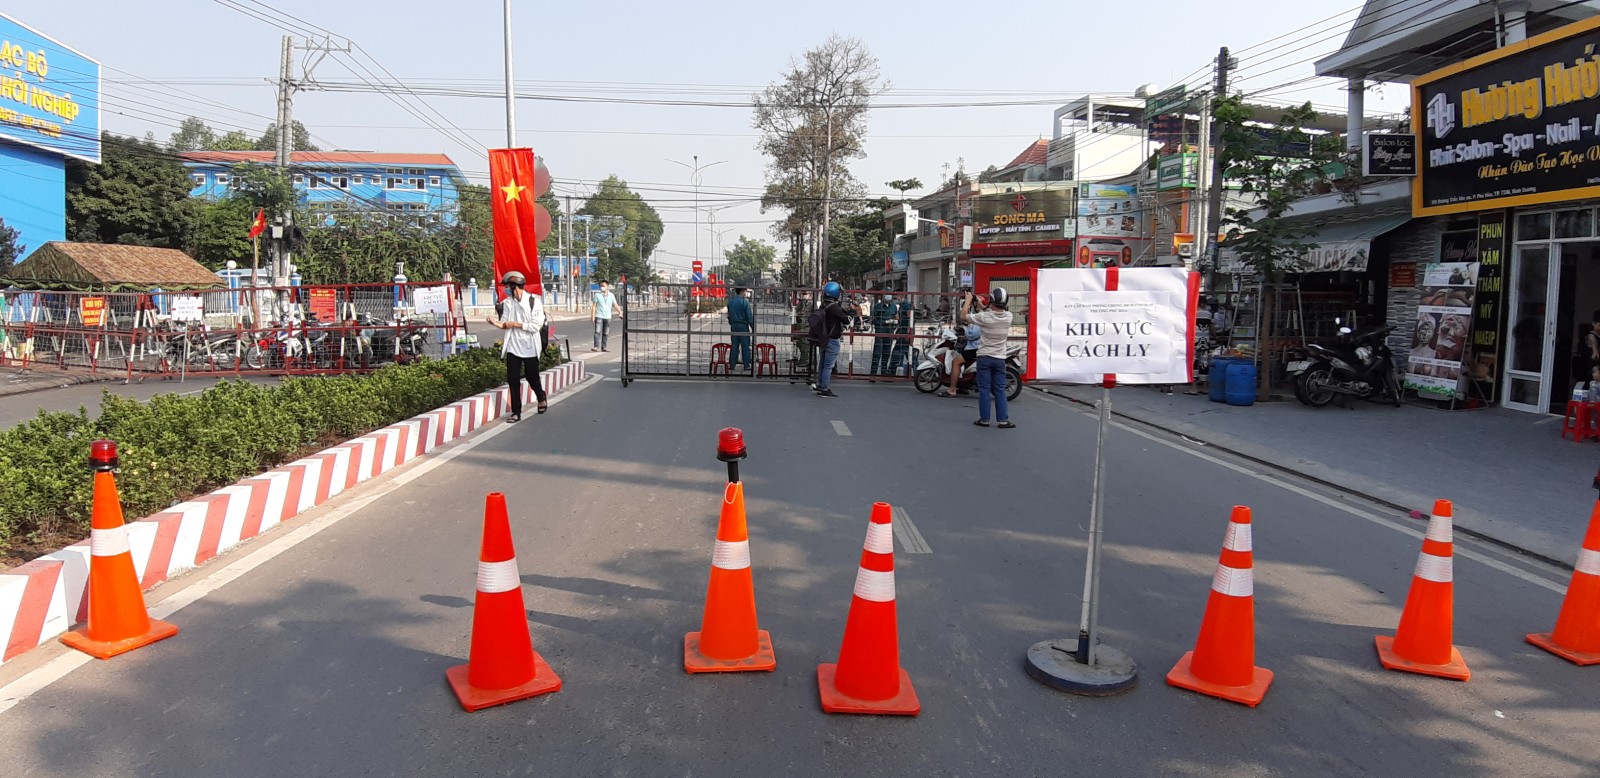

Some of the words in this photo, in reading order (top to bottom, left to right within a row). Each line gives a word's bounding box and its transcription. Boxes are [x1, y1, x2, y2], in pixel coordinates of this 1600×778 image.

[0, 40, 23, 69] ẠC
[26, 49, 48, 82] BỘ
[0, 71, 28, 105] HỞI
[31, 86, 79, 125] NGHIỆP
[1462, 77, 1542, 128] Hương
[1430, 145, 1455, 167] Hair
[1456, 139, 1494, 163] Salon
[1503, 133, 1534, 157] Spa
[1546, 118, 1580, 145] Nail
[1478, 165, 1508, 180] Nhận
[1510, 159, 1534, 174] Đào
[1536, 153, 1557, 173] Tạo
[1560, 150, 1585, 169] Học
[993, 213, 1026, 225] SONG
[1026, 209, 1046, 223] MÃ
[979, 227, 1000, 235] LAPTOP
[1005, 224, 1018, 232] MÁY
[1018, 224, 1031, 232] TÍNH
[1481, 223, 1503, 239] PHUN
[1065, 322, 1106, 336] KHU
[1112, 320, 1152, 339] VỰC
[1066, 340, 1120, 357] CÁCH
[1126, 343, 1151, 357] LY
